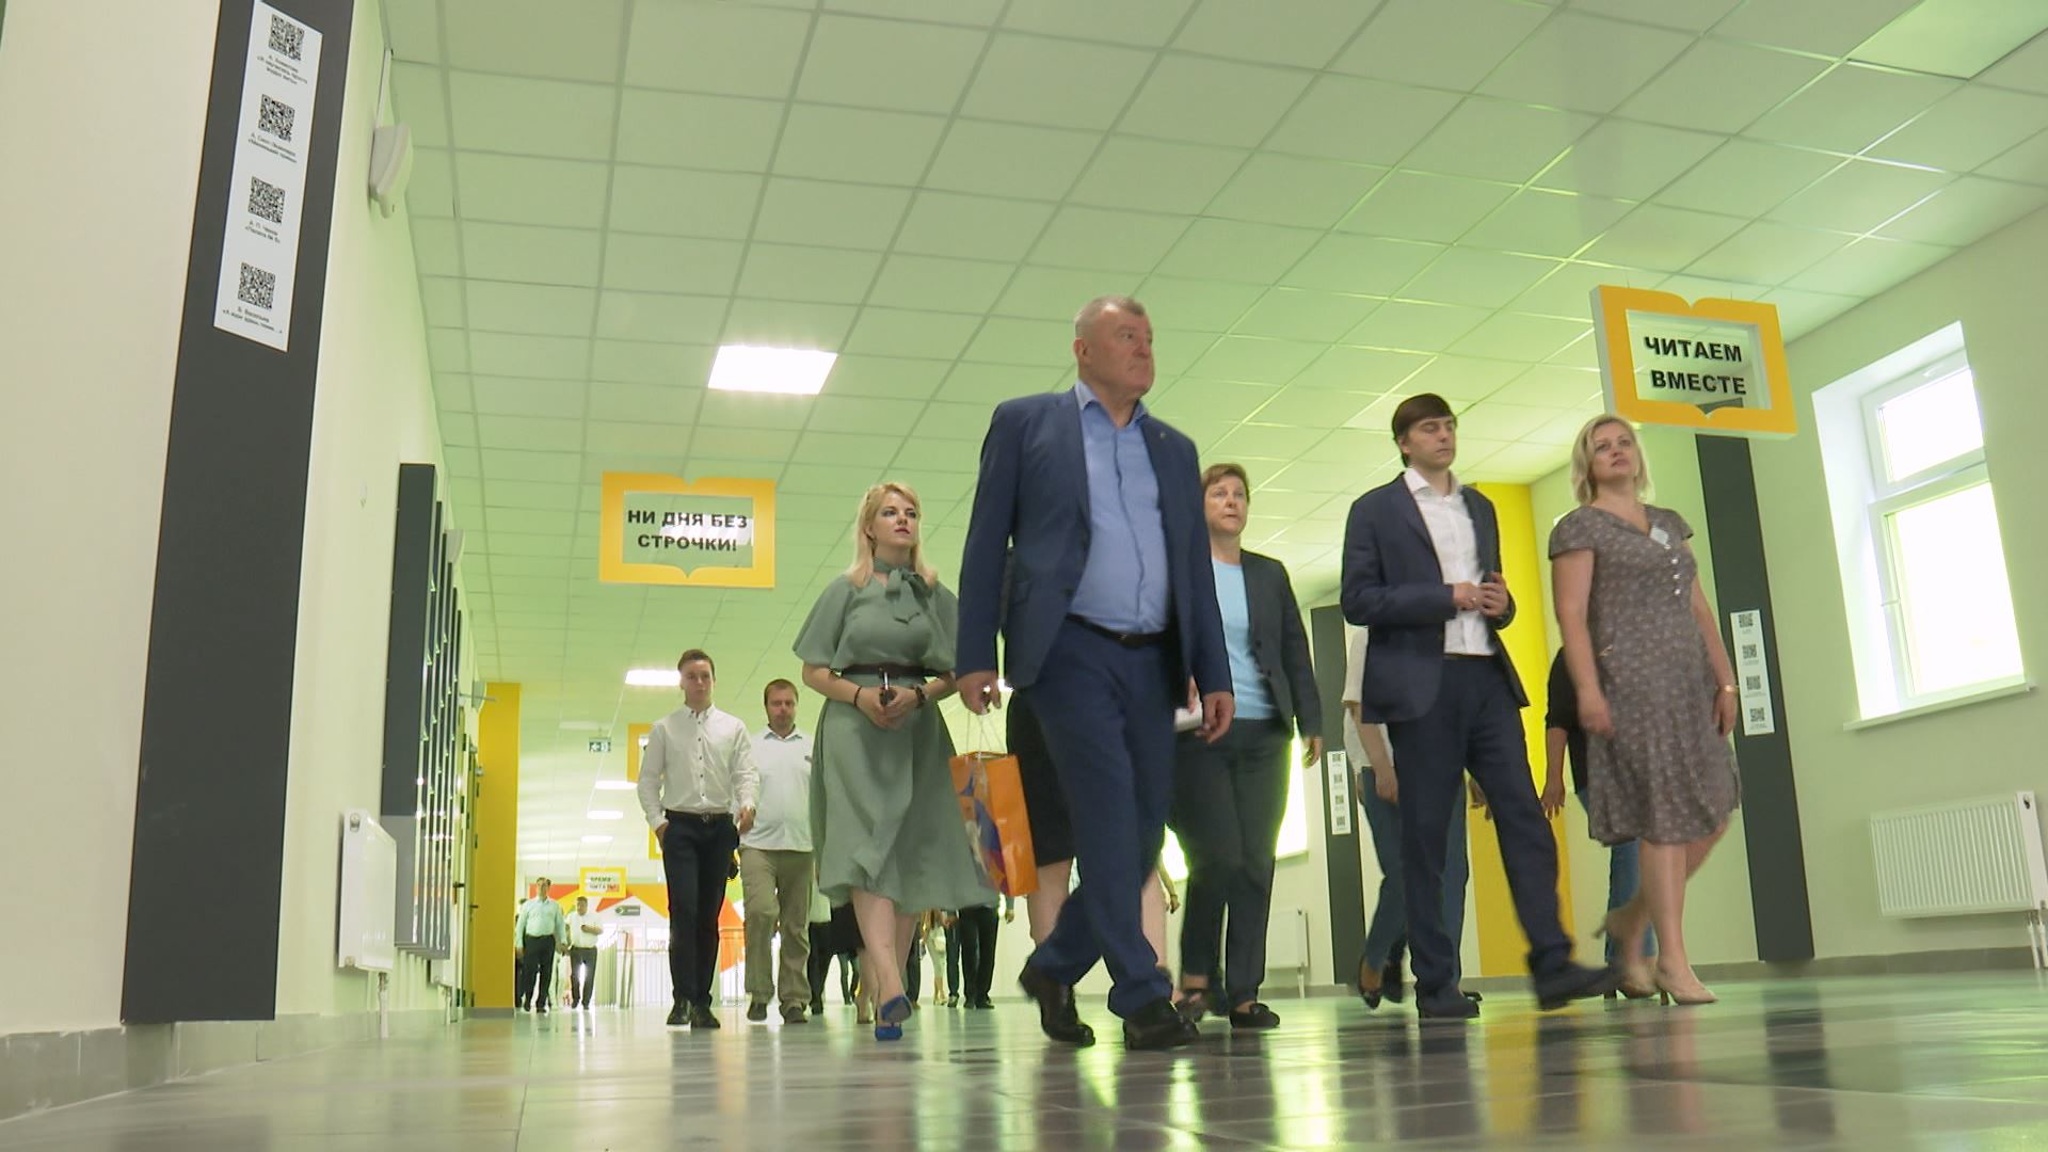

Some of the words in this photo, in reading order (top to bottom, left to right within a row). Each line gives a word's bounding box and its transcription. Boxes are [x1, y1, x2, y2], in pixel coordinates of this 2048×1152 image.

[1644, 336, 1742, 362] ЧИТАЕМ
[1651, 370, 1747, 395] ВМЕСТЕ
[627, 510, 655, 524] НИ
[662, 512, 703, 527] ДНЯ
[711, 514, 748, 528] БЕЗ
[637, 534, 737, 552] СТРОЧКИ!
